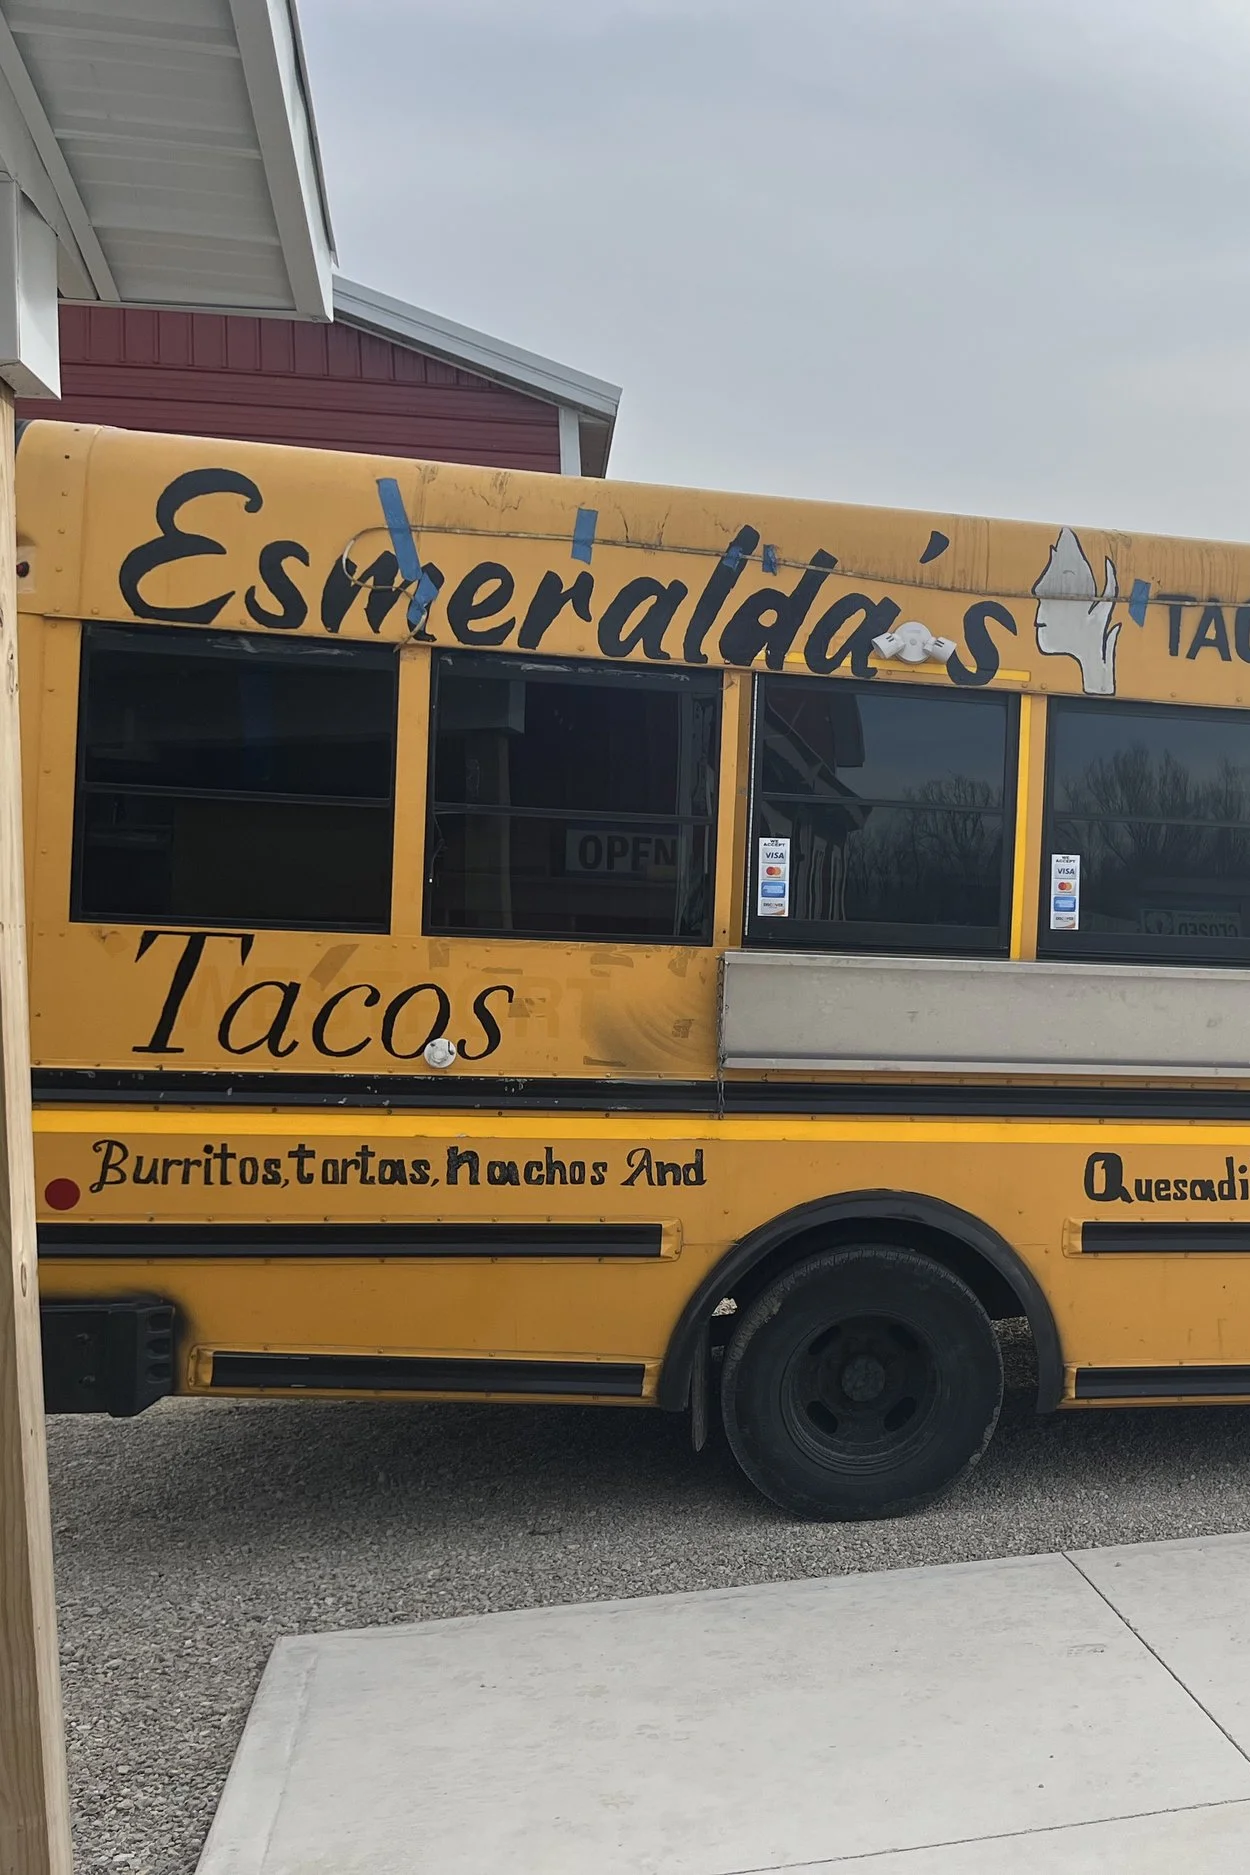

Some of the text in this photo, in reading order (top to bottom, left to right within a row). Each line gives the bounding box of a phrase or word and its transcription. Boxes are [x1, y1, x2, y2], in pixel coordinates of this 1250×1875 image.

[119, 468, 1018, 686] Esmeralda's
[132, 930, 515, 1061] Tacos
[620, 1147, 707, 1187] And
